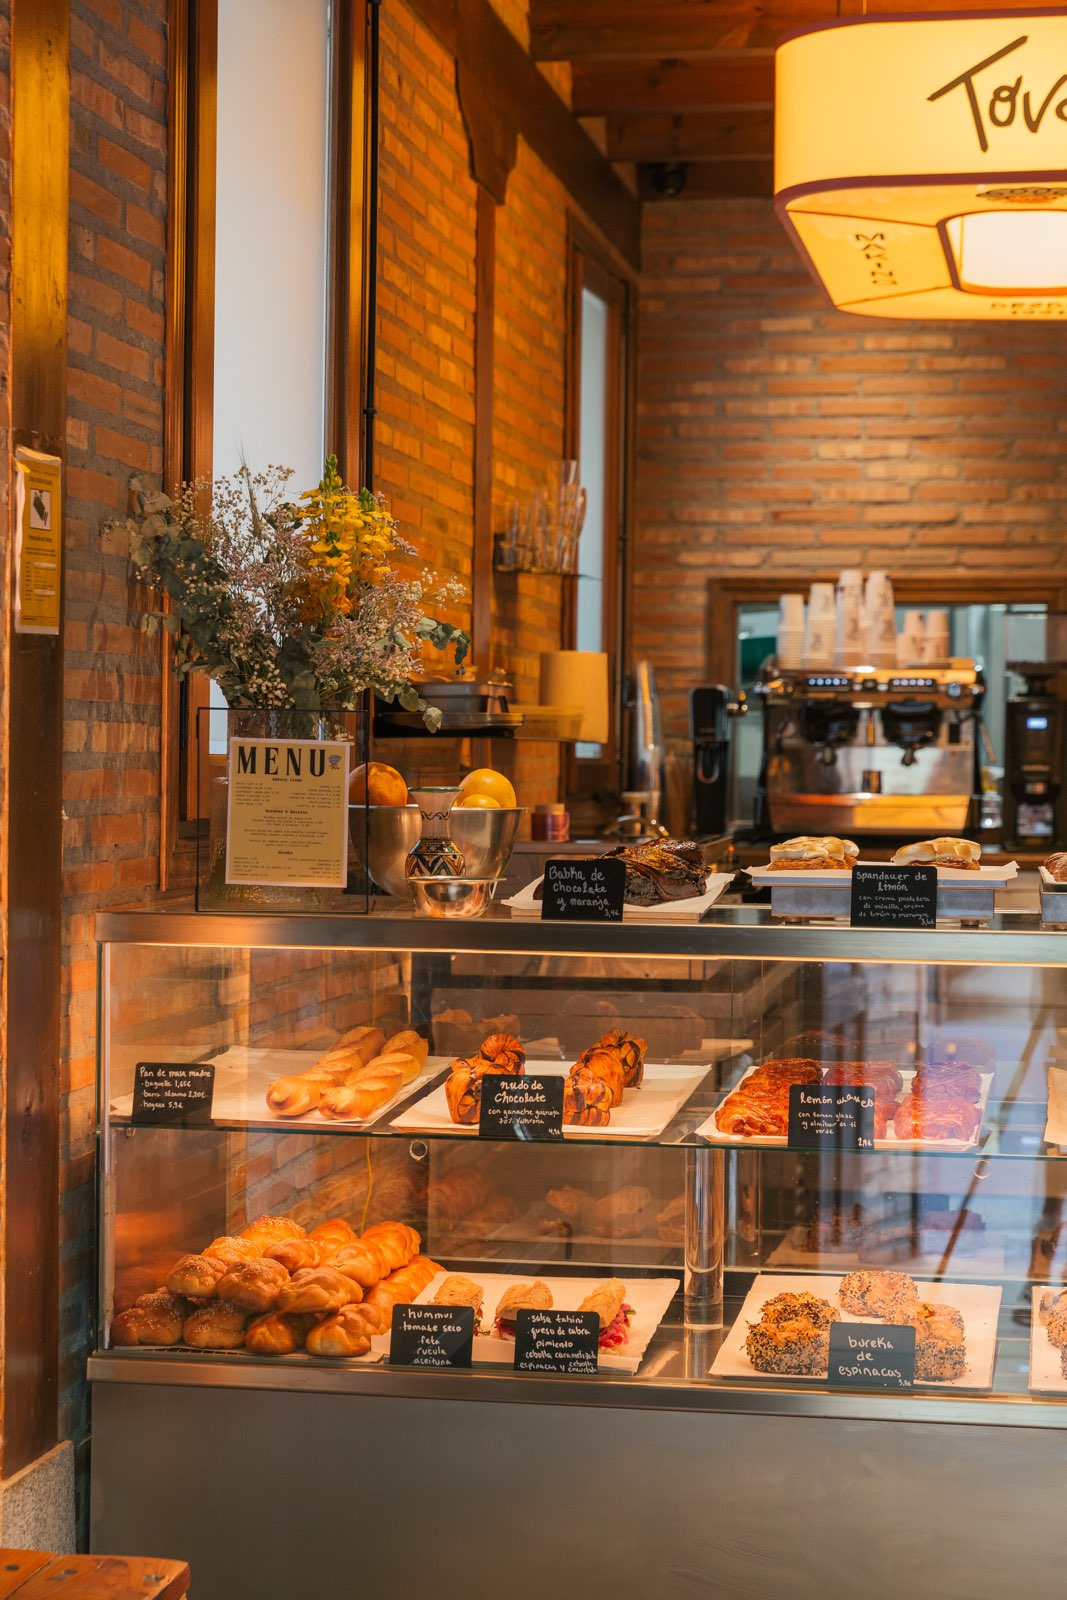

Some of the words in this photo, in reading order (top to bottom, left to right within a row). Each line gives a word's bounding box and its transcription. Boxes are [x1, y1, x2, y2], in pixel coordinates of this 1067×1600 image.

[238, 746, 325, 776] MENU
[549, 866, 586, 880] Babka
[591, 868, 605, 880] de
[856, 871, 909, 882] Spandauer
[915, 872, 927, 880] de
[557, 897, 566, 911] y
[570, 896, 610, 910] naranja
[140, 1066, 154, 1078] Pan
[157, 1069, 166, 1077] de
[531, 1080, 544, 1090] de
[503, 1108, 533, 1118] ganache
[408, 1308, 452, 1319] hummus
[532, 1313, 551, 1323] salsa
[556, 1314, 584, 1323] tahini
[403, 1321, 438, 1332] tomate
[531, 1327, 555, 1340] queso
[557, 1326, 565, 1335] de
[568, 1326, 590, 1335] cabra
[421, 1335, 440, 1345] feta
[536, 1340, 573, 1349] pimiento
[417, 1346, 447, 1355] rucula
[526, 1350, 552, 1359] cebolla
[856, 1351, 873, 1360] de
[414, 1357, 452, 1365] aceituna
[520, 1362, 557, 1370] espinacas
[838, 1363, 902, 1378] espinacas
